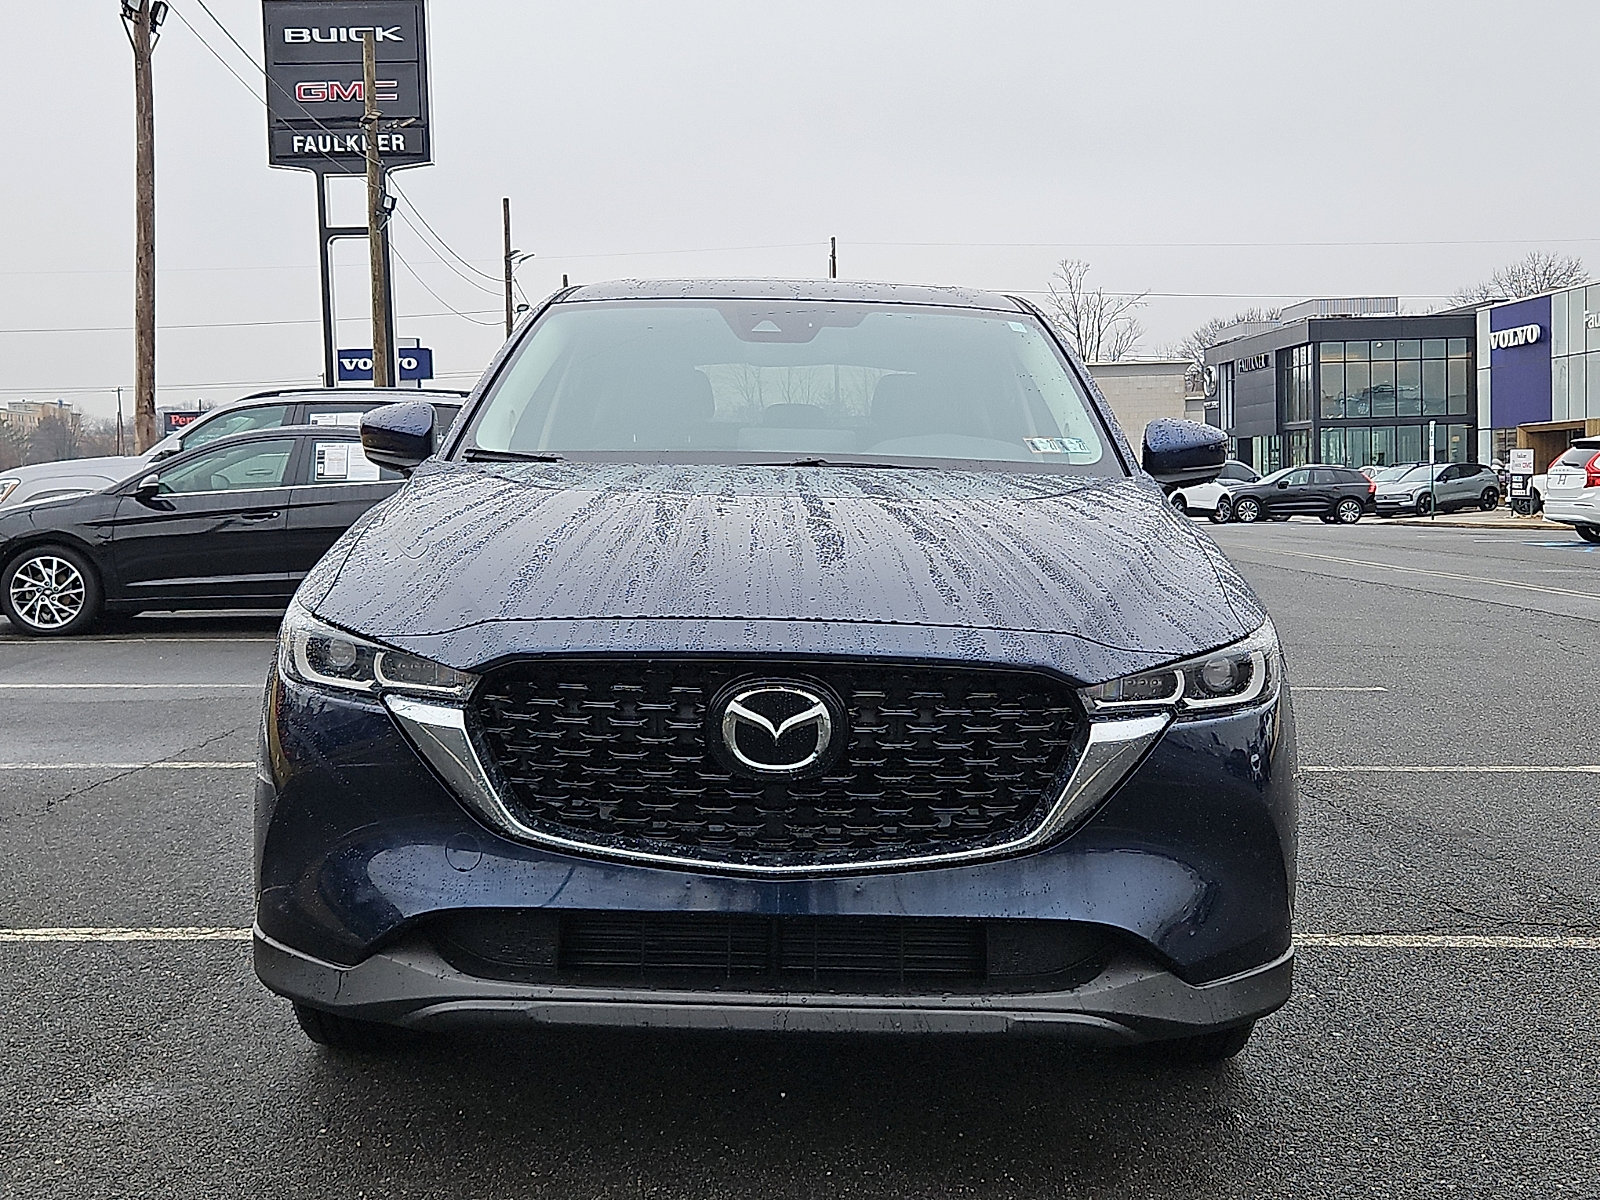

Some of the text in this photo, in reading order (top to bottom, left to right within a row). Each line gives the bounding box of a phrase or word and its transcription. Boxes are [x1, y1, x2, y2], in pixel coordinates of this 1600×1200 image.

[284, 26, 404, 43] BUICK
[292, 134, 405, 153] FAULKER
[1490, 324, 1540, 349] VOLVO
[340, 357, 418, 370] VOO
